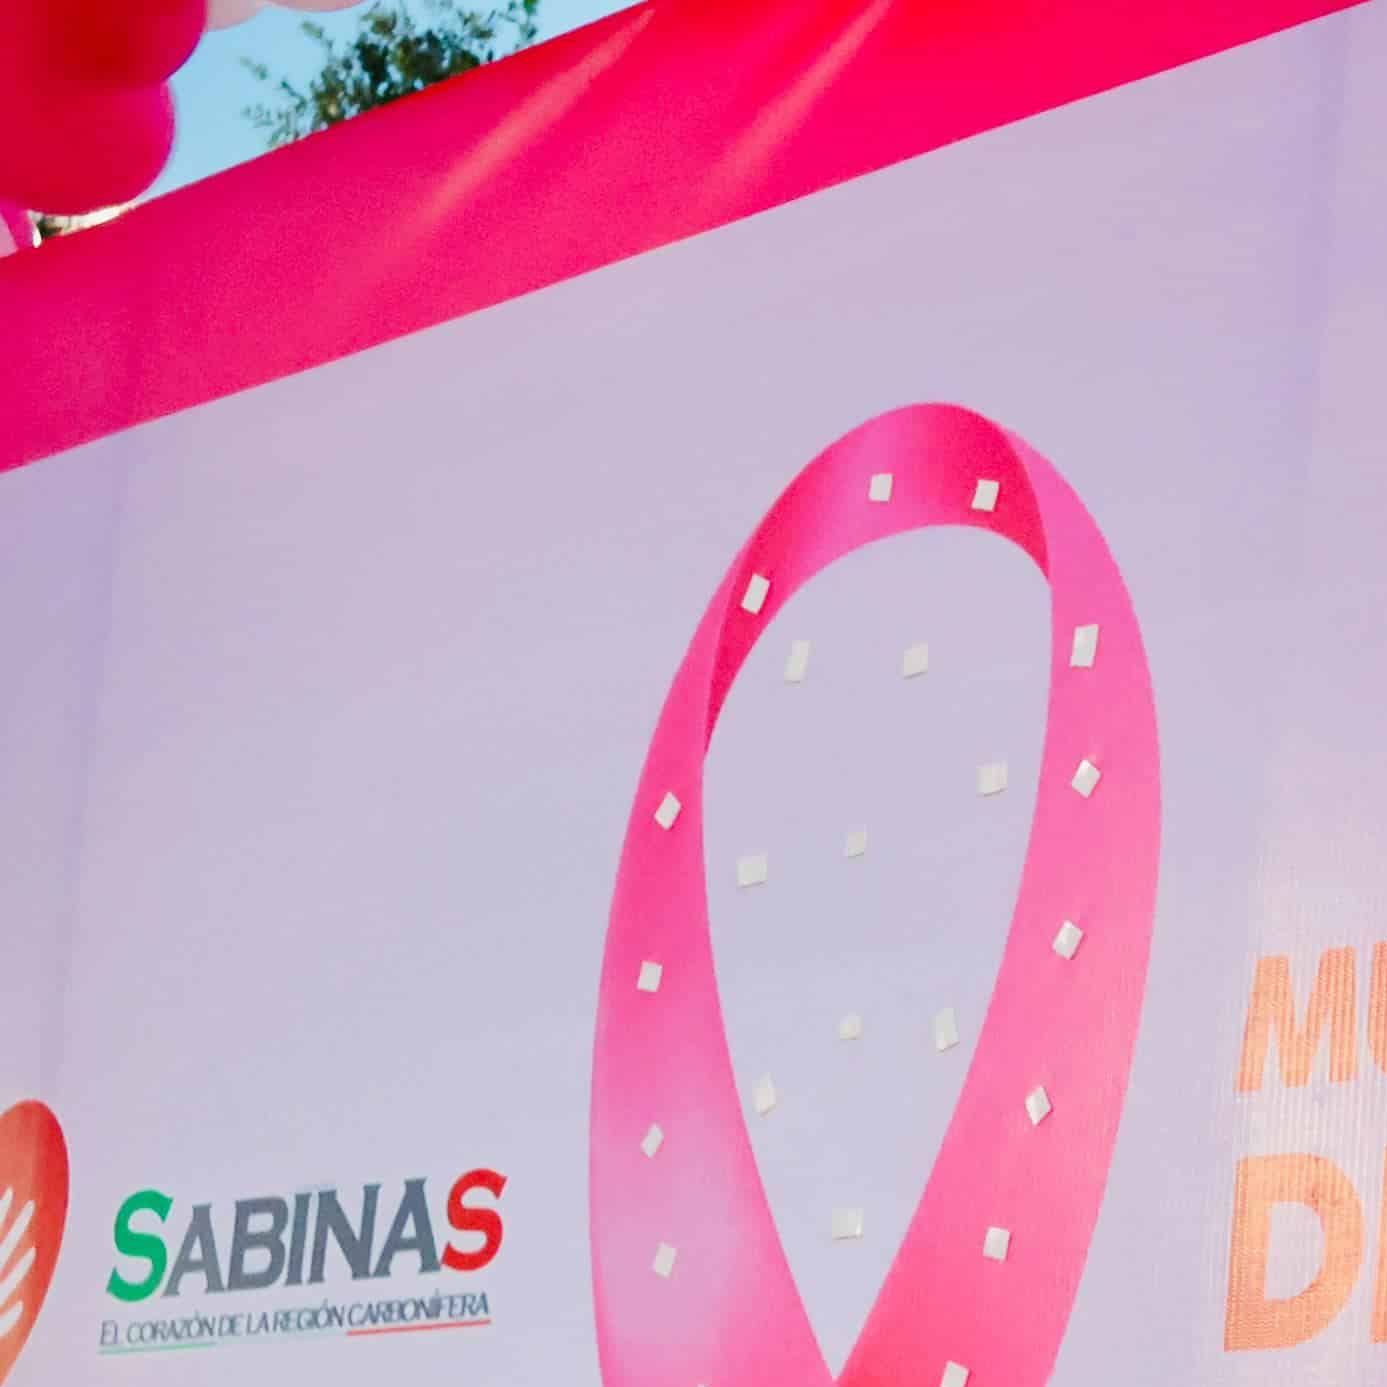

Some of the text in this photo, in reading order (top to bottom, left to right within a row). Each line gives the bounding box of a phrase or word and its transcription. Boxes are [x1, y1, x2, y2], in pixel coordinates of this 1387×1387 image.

[106, 1168, 507, 1302] SABINAS
[99, 1288, 491, 1345] EL CORAZÓN DE LA REGIÓN CARBONÍFERA
